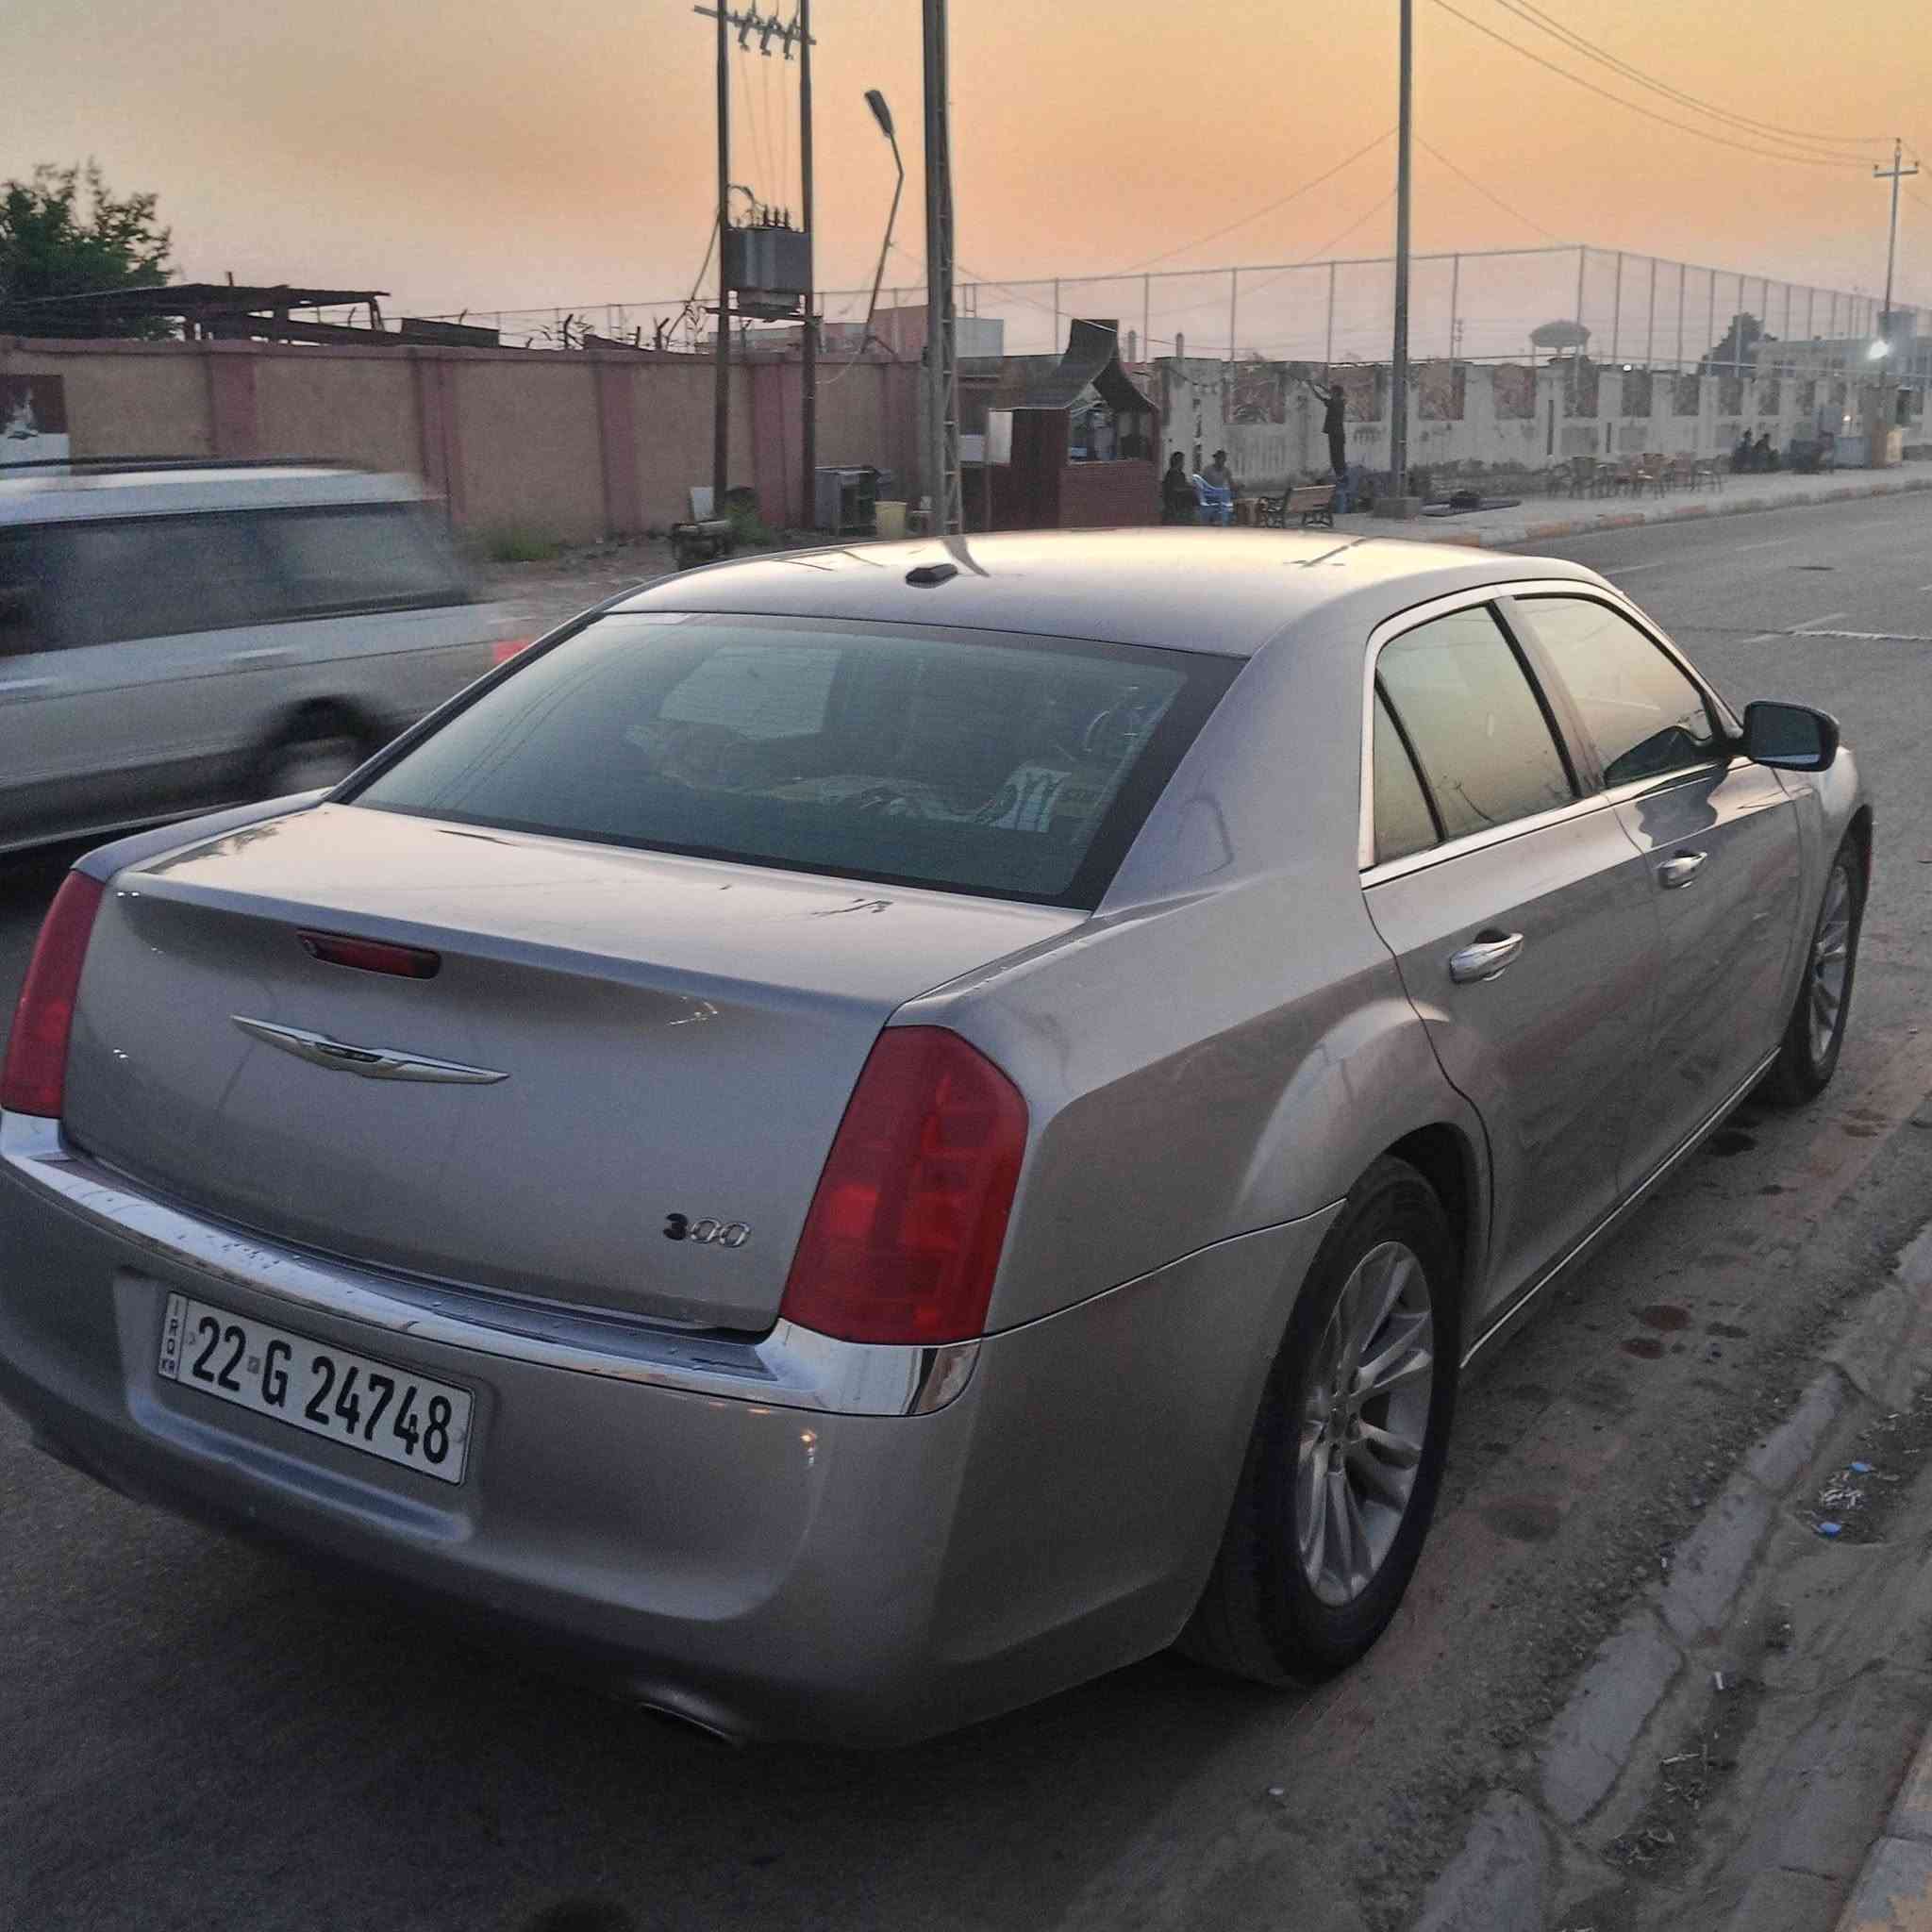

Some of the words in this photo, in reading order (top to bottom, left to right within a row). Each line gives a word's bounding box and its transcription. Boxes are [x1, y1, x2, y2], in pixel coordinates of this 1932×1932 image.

[663, 1213, 751, 1248] 300
[192, 1316, 246, 1391] 22
[261, 1340, 292, 1407] G
[305, 1356, 453, 1464] 24748
